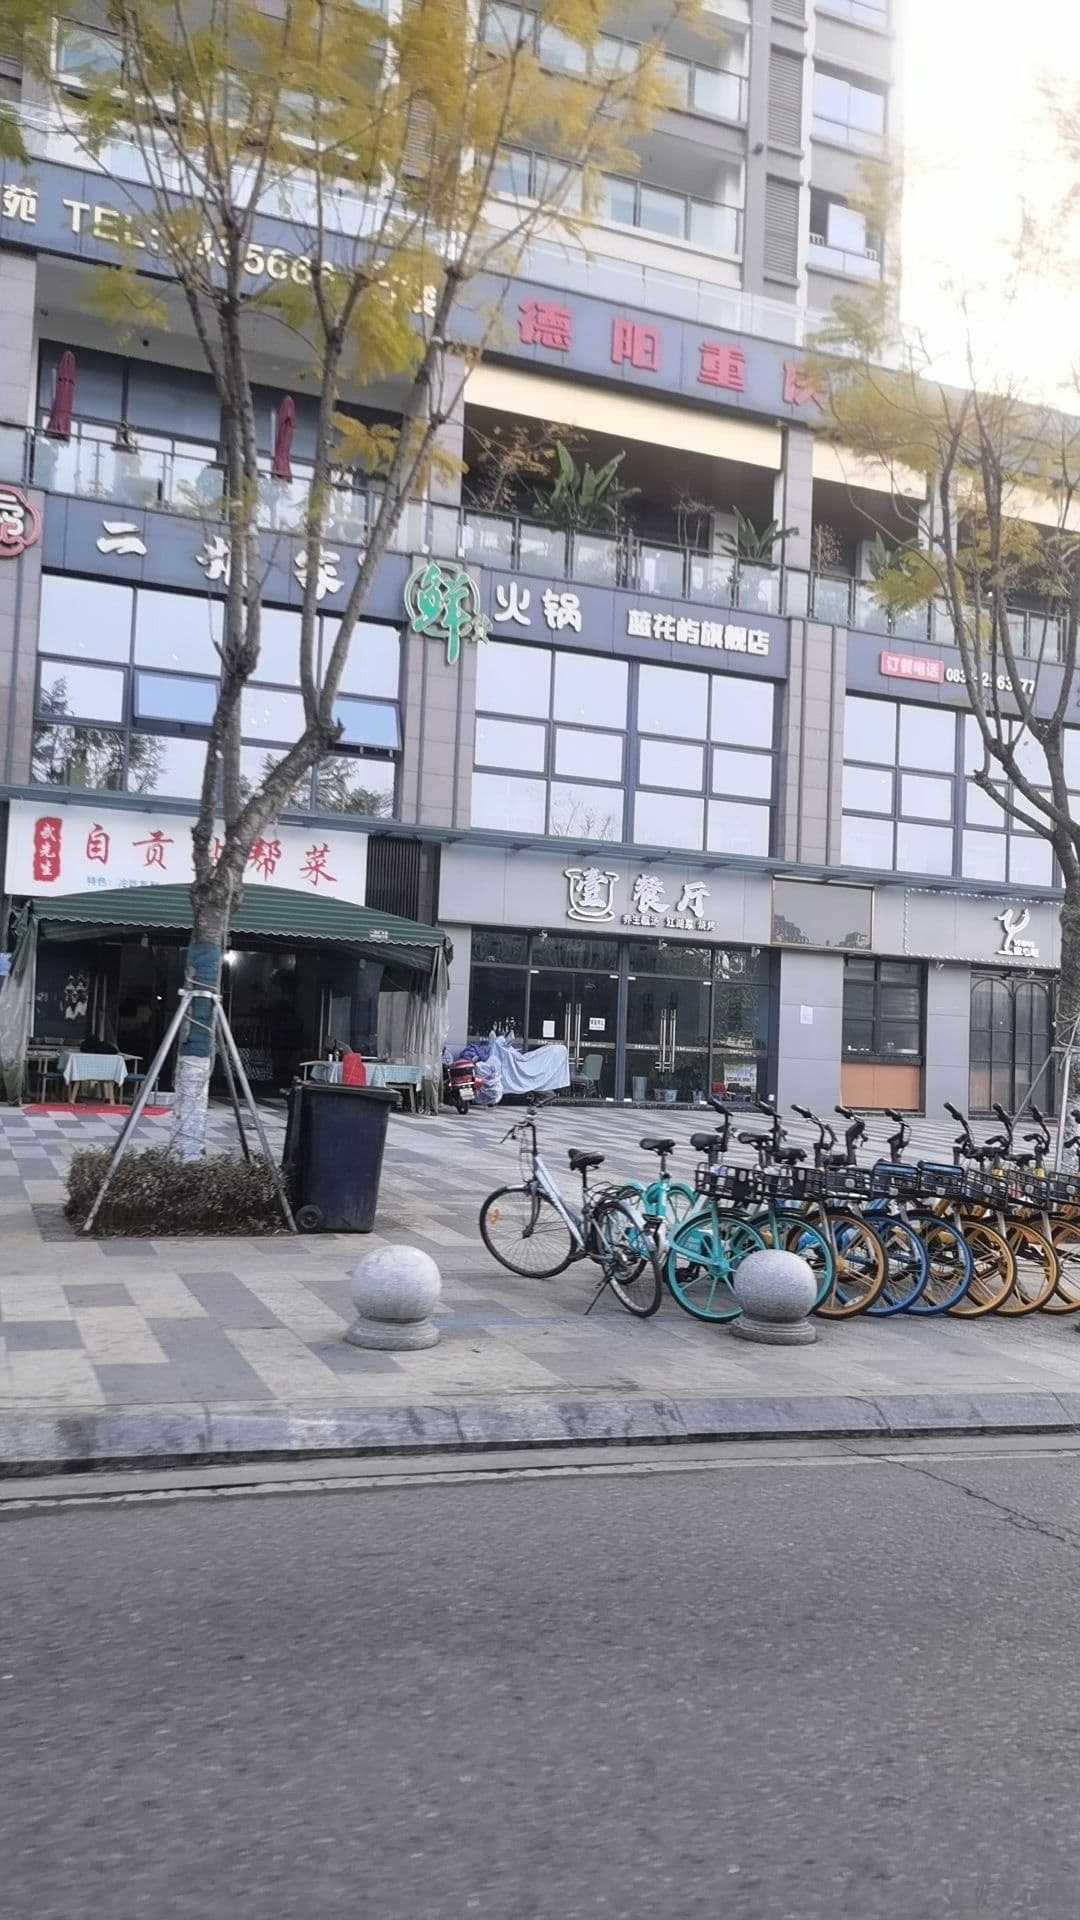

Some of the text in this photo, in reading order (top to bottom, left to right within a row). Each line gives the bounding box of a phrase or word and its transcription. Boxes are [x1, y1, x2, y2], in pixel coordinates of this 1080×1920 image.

[494, 581, 583, 634] 火锅
[86, 822, 338, 887] 自贡帮菜
